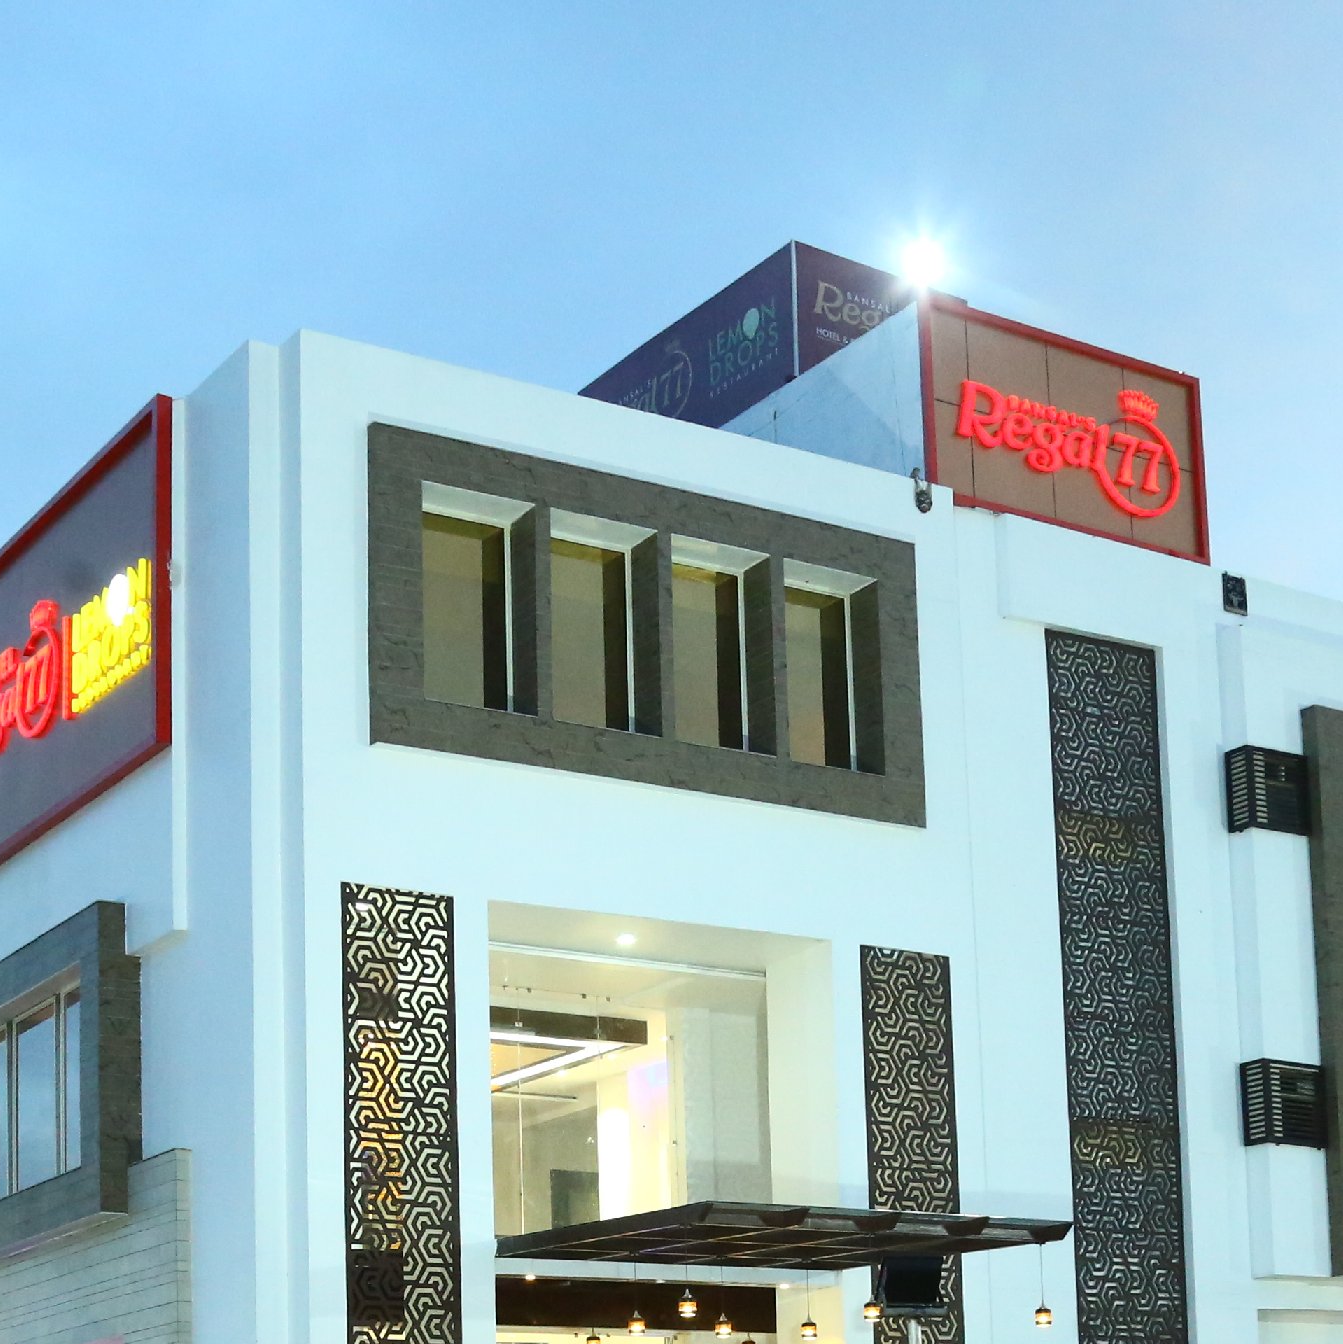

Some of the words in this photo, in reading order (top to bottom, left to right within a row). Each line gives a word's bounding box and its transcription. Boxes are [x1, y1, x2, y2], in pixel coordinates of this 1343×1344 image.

[709, 321, 778, 386] DROPS
[957, 379, 1110, 473] Regal
[1113, 431, 1165, 494] 77
